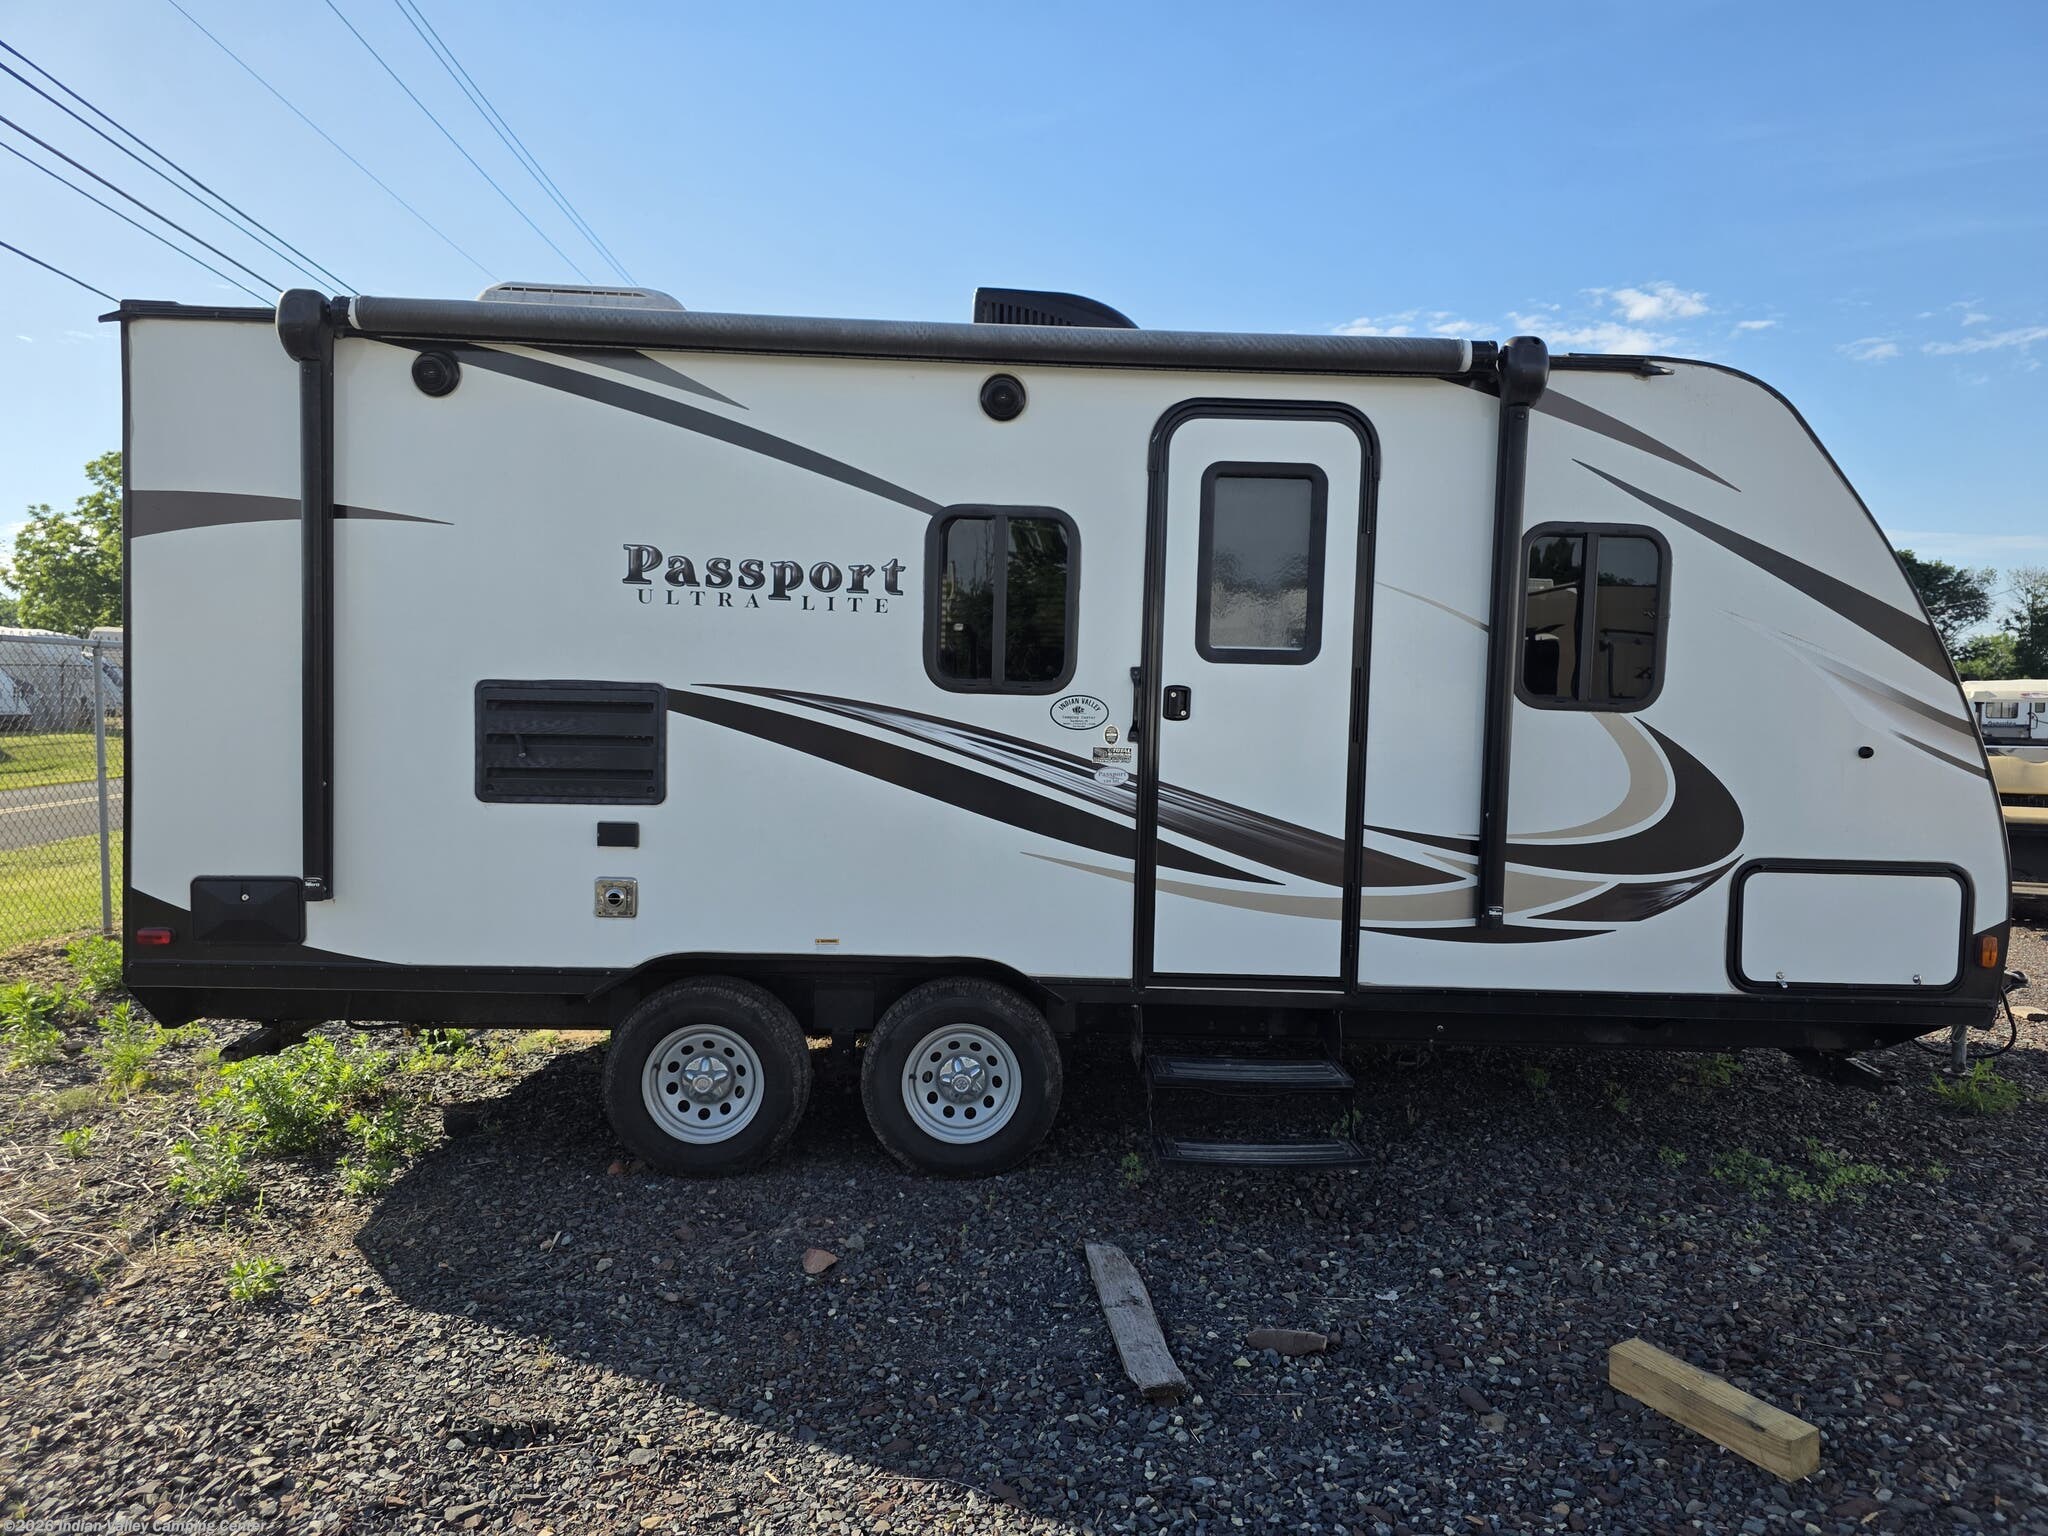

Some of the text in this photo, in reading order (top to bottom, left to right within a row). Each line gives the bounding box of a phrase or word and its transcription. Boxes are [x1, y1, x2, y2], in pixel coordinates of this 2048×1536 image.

[622, 543, 906, 600] Passport
[638, 589, 889, 614] ULTRA LITE
[1058, 697, 1080, 711] INDIAN
[1081, 697, 1102, 711] VALLEY
